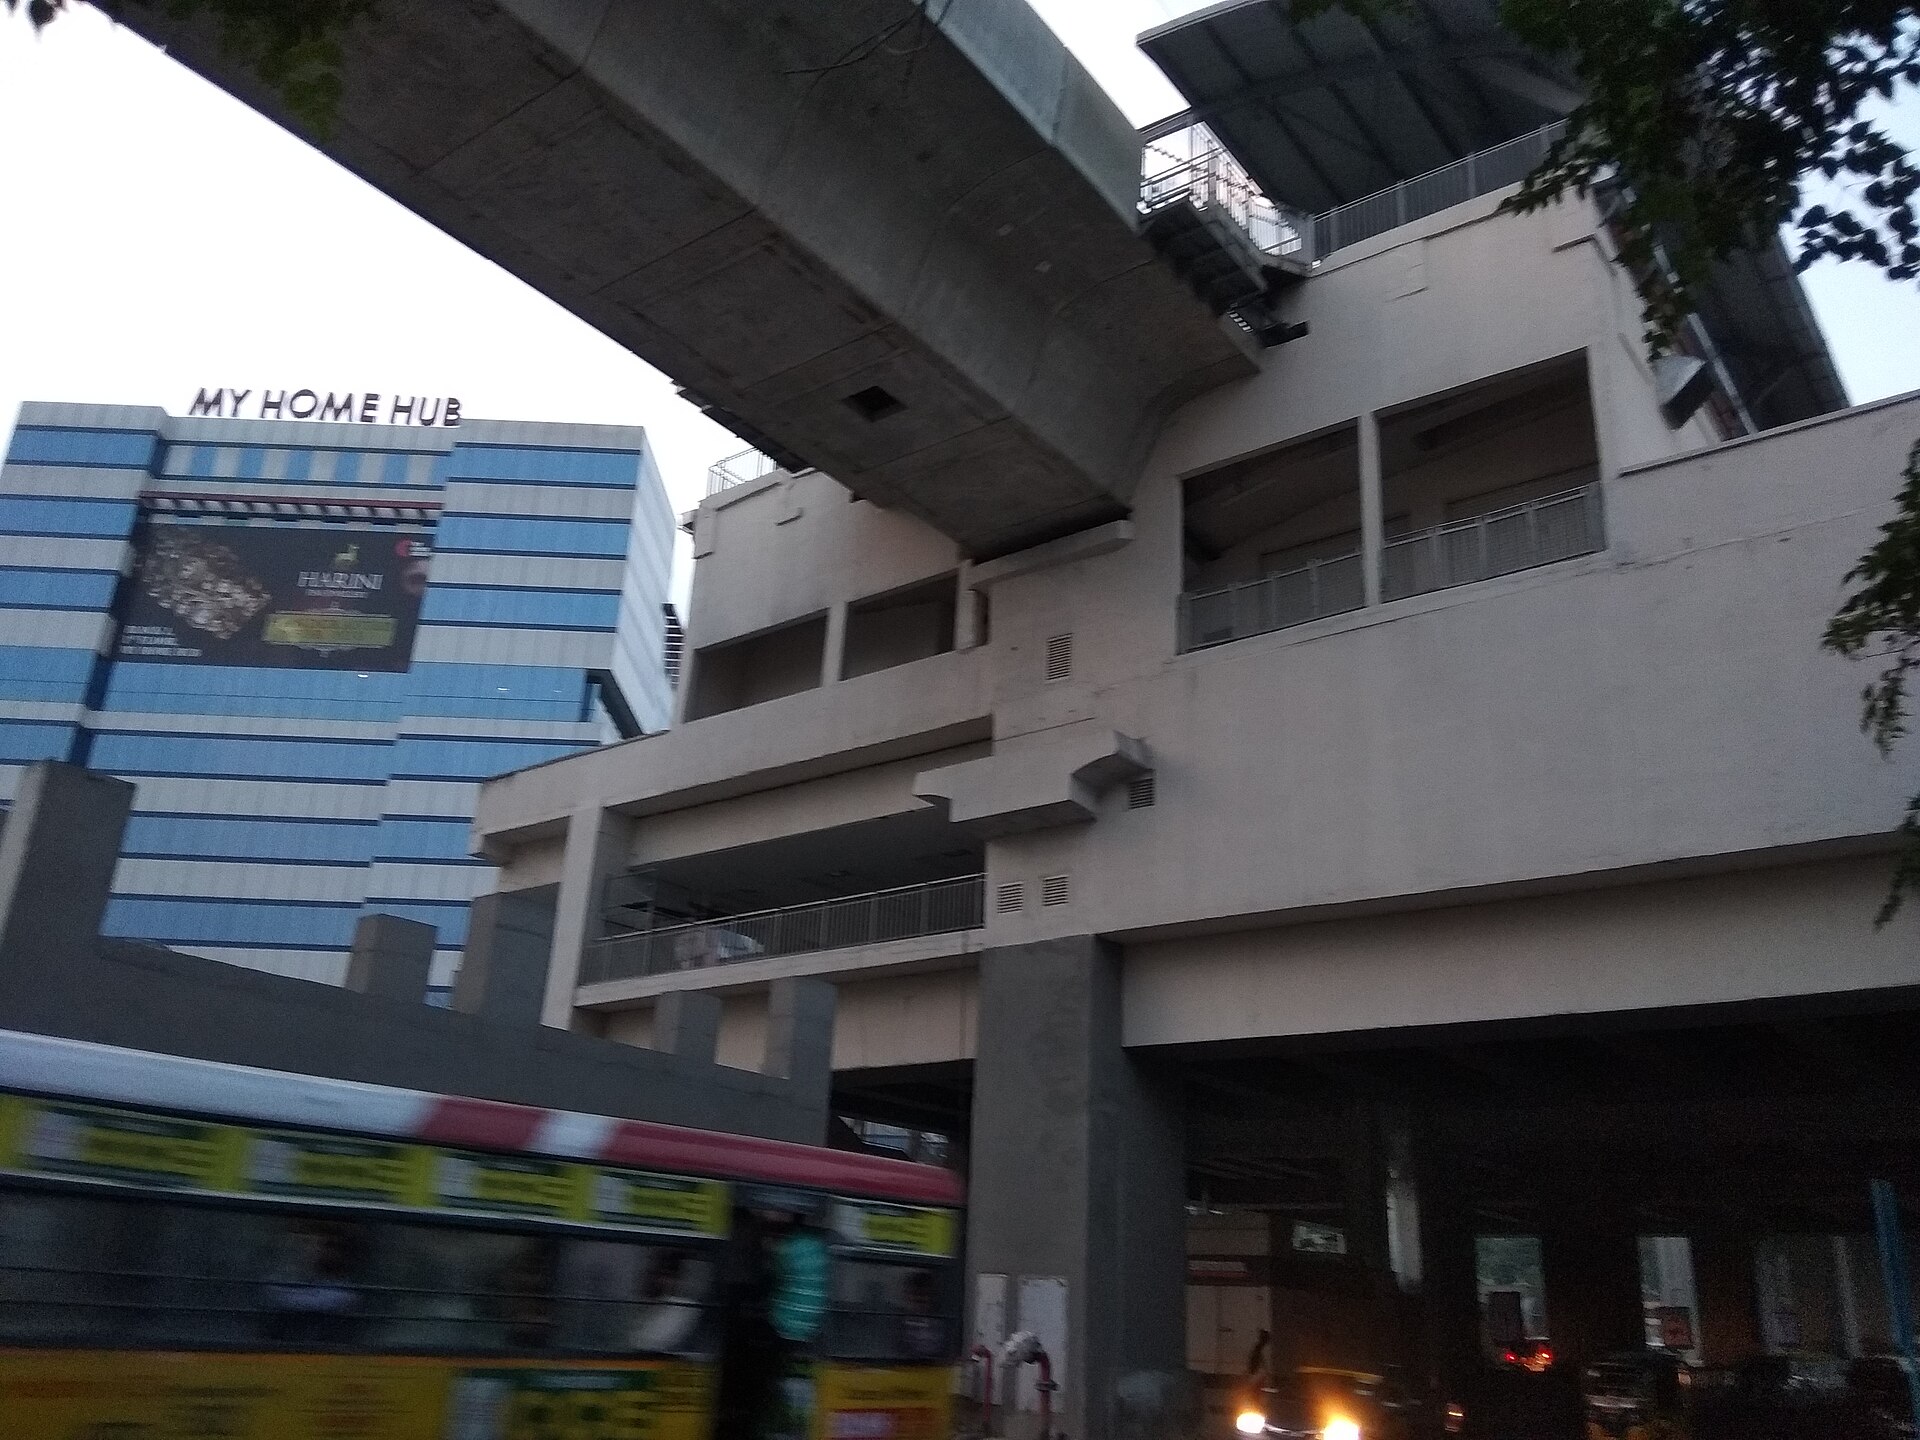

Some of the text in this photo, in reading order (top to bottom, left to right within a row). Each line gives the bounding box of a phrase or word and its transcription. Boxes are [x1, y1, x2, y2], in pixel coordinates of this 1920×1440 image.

[189, 387, 461, 426] MY HOME HUB
